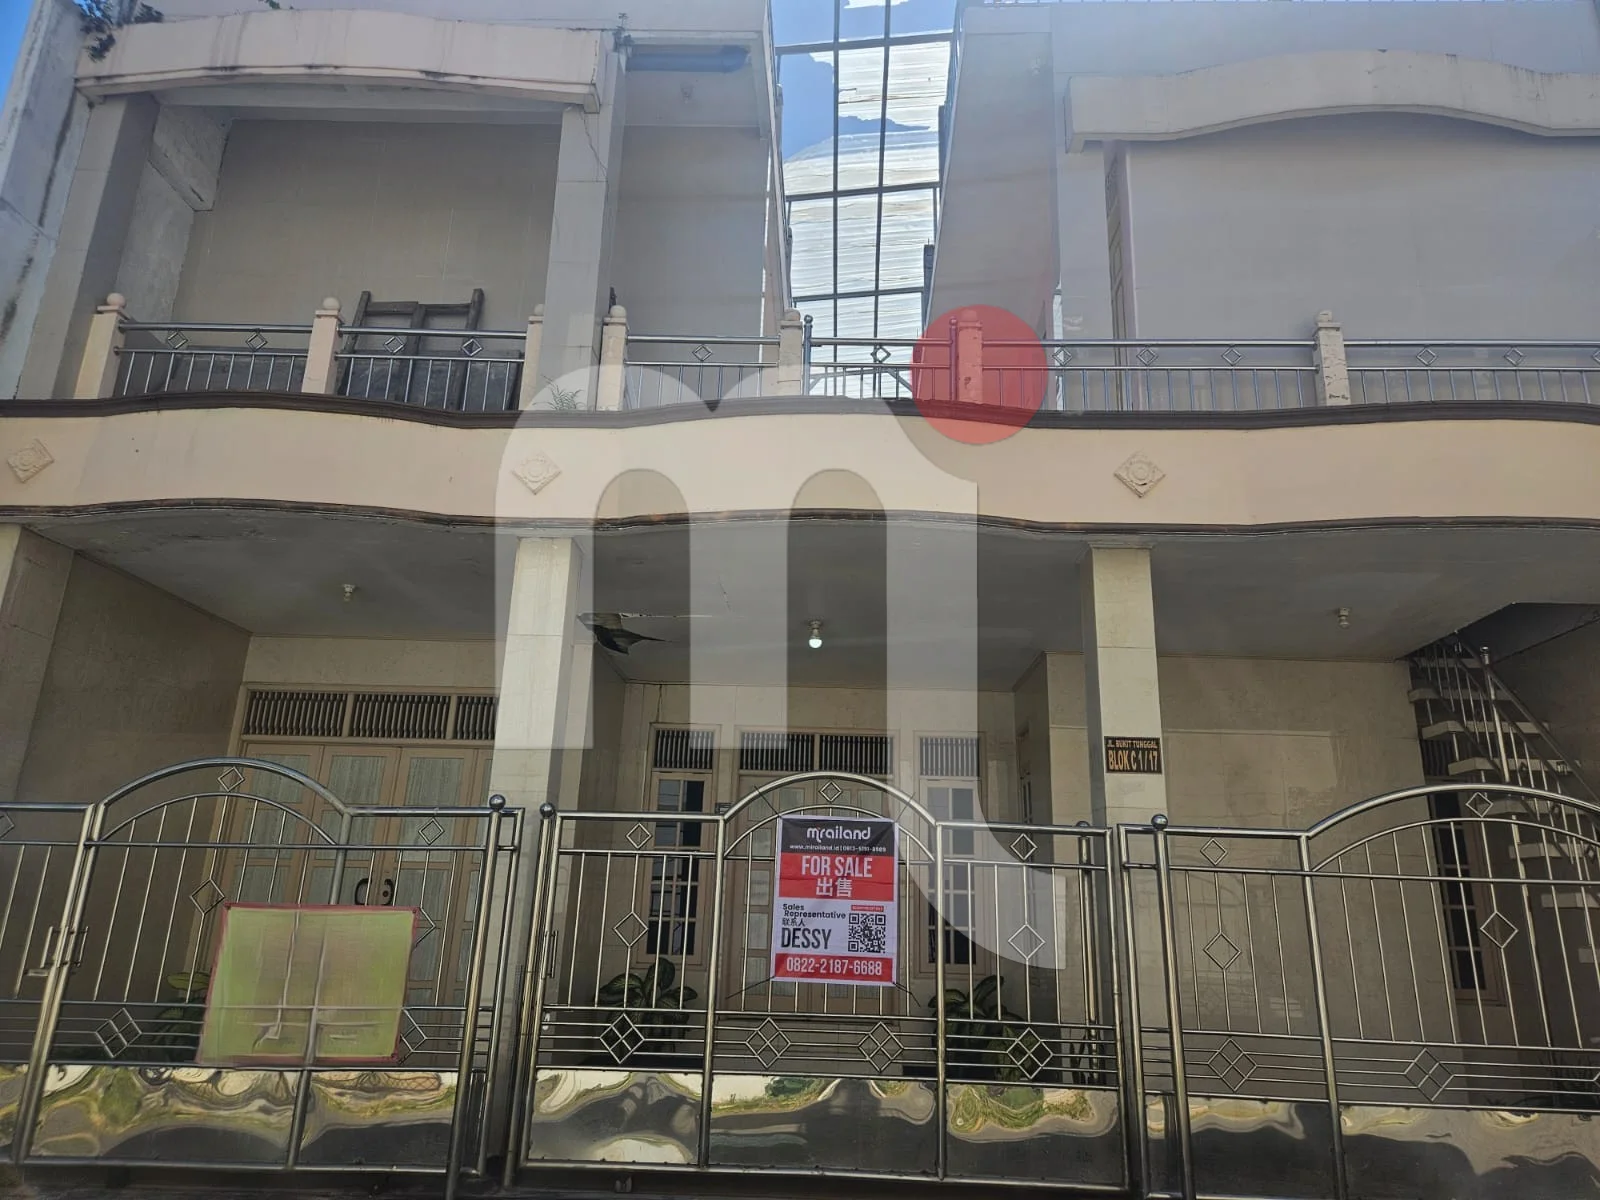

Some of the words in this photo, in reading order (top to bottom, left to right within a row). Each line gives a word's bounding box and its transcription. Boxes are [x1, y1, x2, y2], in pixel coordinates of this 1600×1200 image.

[1108, 750, 1130, 770] BLOK
[801, 855, 831, 876] FOR
[834, 857, 873, 878] SALE
[815, 876, 853, 897] 出售
[783, 903, 805, 911] Sales
[784, 910, 846, 920] Representative
[781, 927, 832, 950] DESSY
[786, 957, 882, 976] 0822-2187-6688
